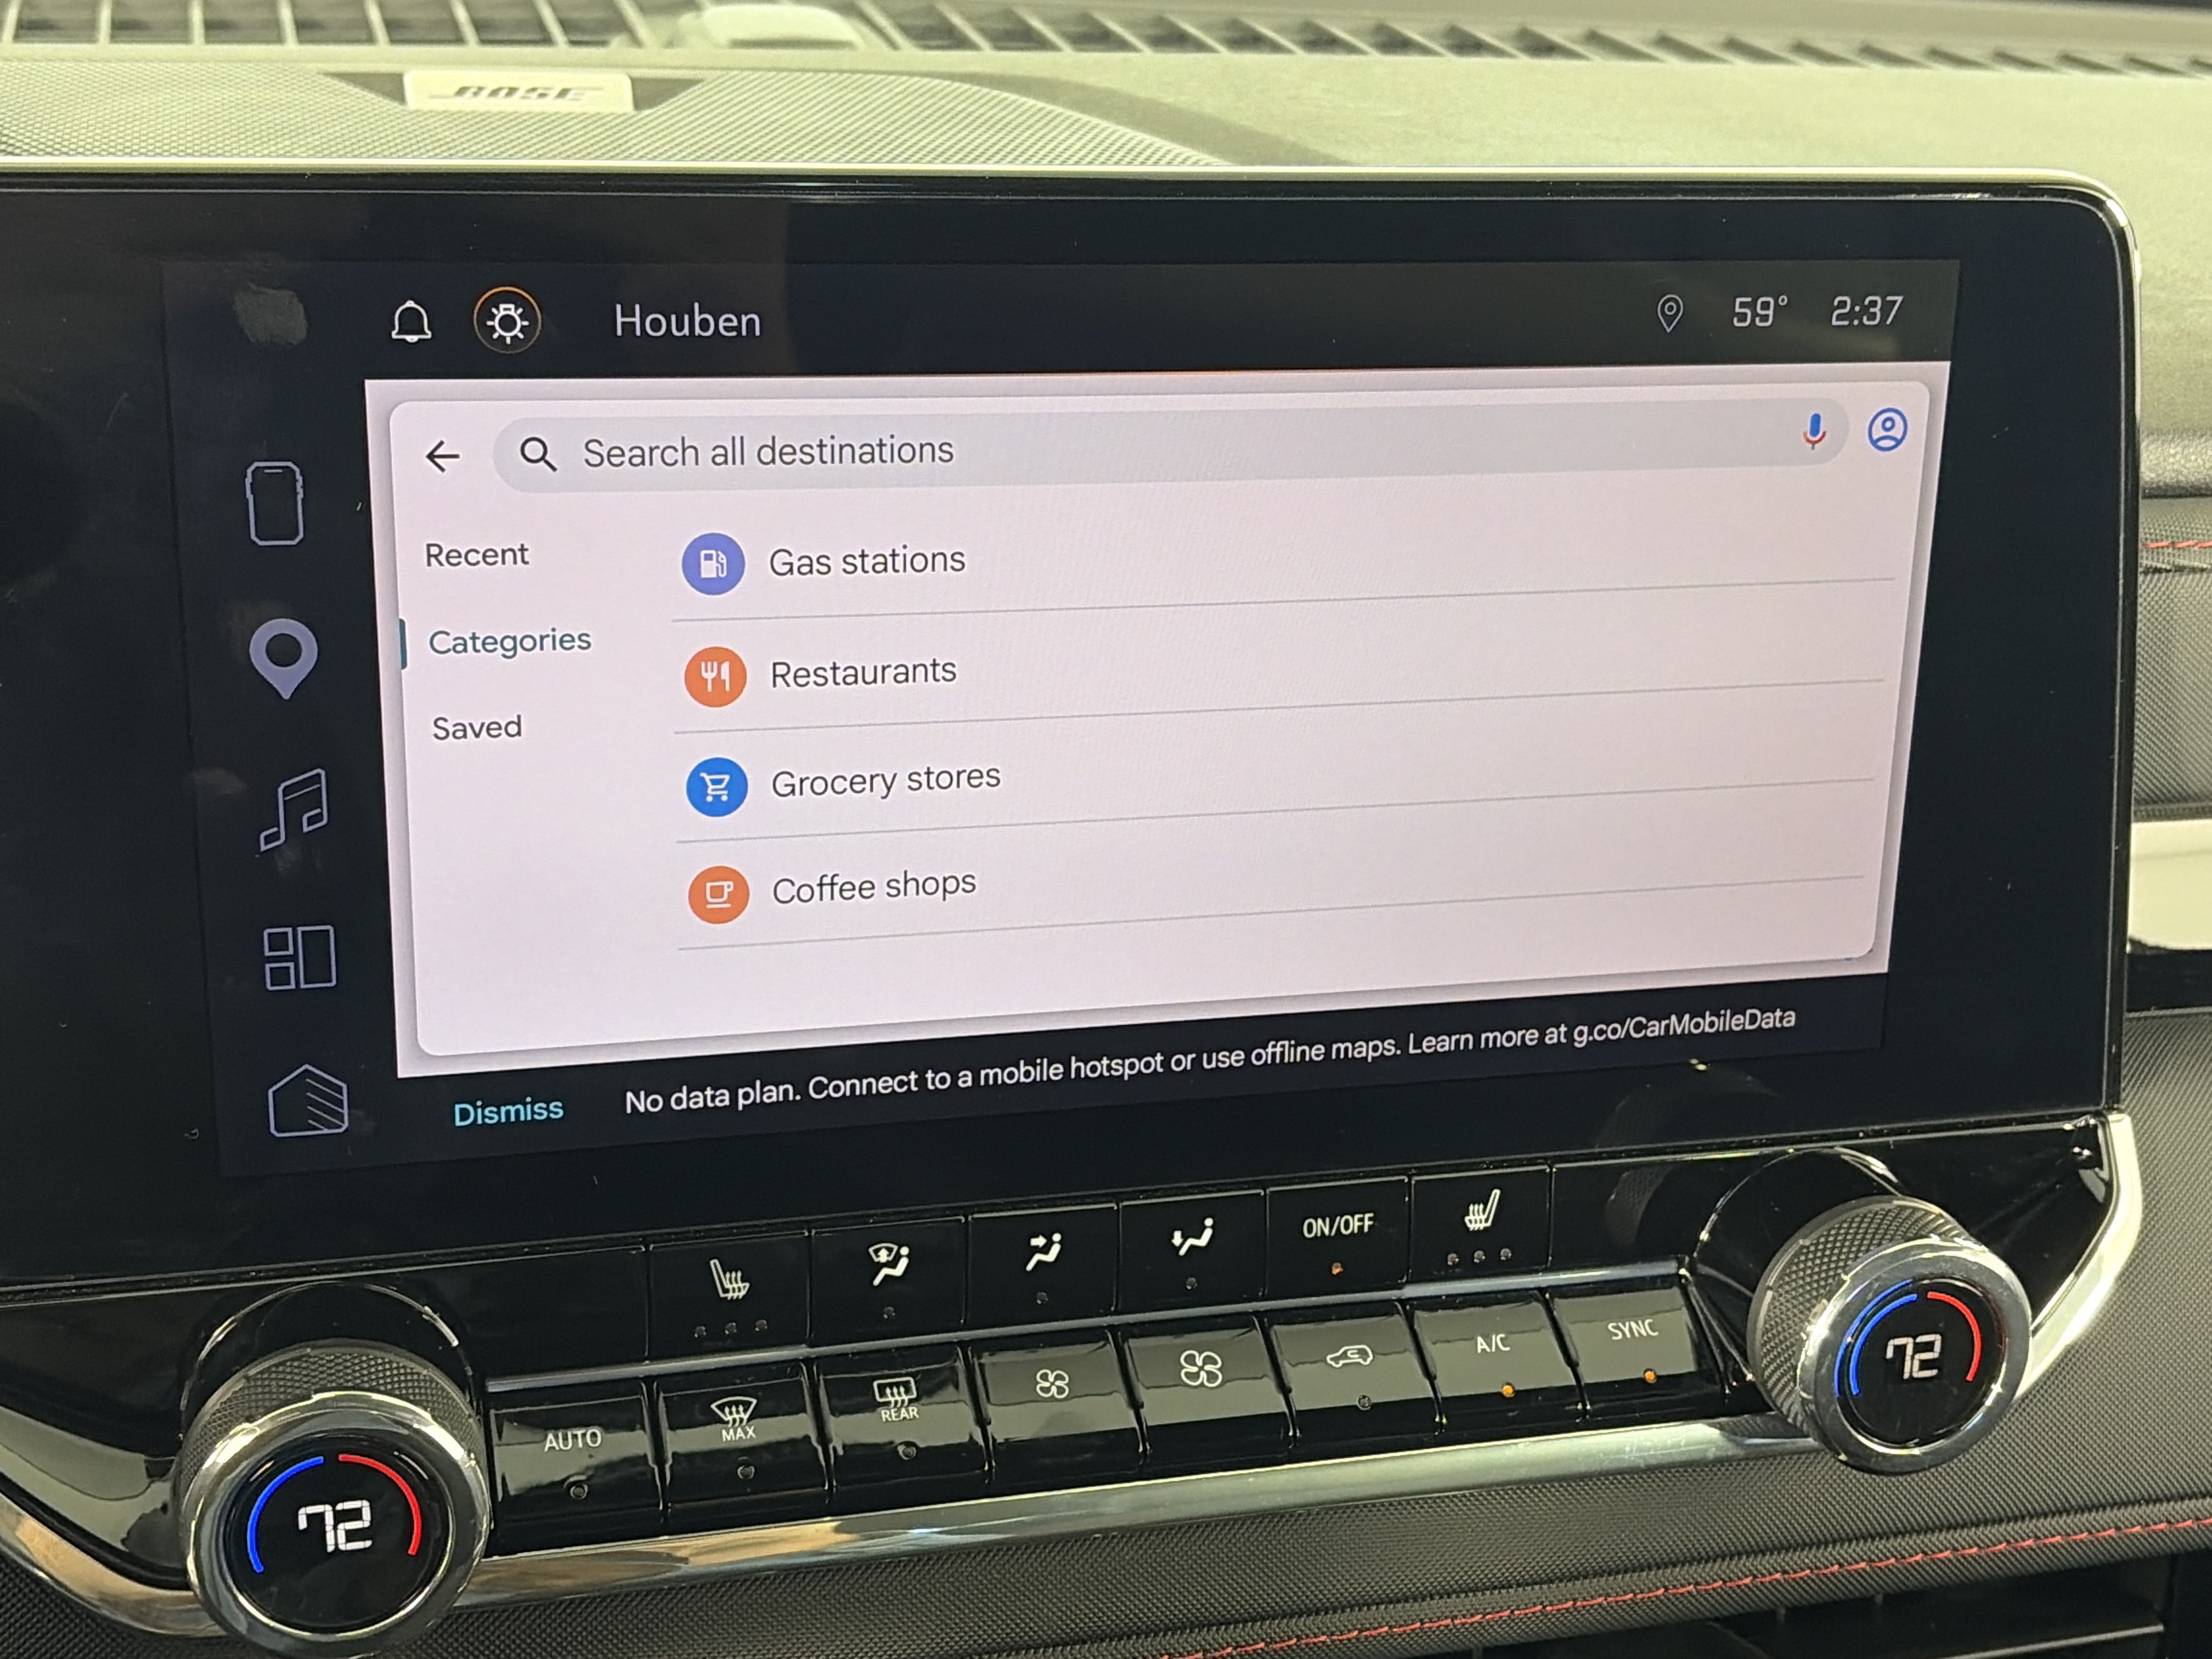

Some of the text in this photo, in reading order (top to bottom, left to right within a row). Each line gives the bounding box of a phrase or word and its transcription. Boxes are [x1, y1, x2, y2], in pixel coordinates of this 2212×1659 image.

[453, 86, 585, 101] BOSE
[615, 303, 761, 336] Houben
[1831, 296, 1904, 326] 2:37
[584, 434, 954, 467] Search all destinations
[426, 543, 530, 567] Recent
[770, 544, 966, 576] Gas stations
[429, 627, 591, 659] Categories
[771, 658, 957, 688] Restaurants
[433, 714, 522, 740] Saved
[772, 766, 1001, 799] Grocery stores
[773, 870, 977, 905] Coffee shops
[625, 1008, 1797, 1114] No data plan. Connect to a mobile hotspot or use offline maps. Learn more at g.co/CarMobileData
[454, 1097, 564, 1127] Dismiss
[1302, 1212, 1374, 1238] ON/OFF
[1476, 1333, 1511, 1354] A/C
[1607, 1319, 1659, 1341] SYNC
[1885, 1333, 1942, 1380] 72
[881, 1407, 919, 1423] REAR
[544, 1429, 602, 1452] AUTO
[721, 1426, 757, 1442] MAX
[297, 1499, 373, 1553] 72
